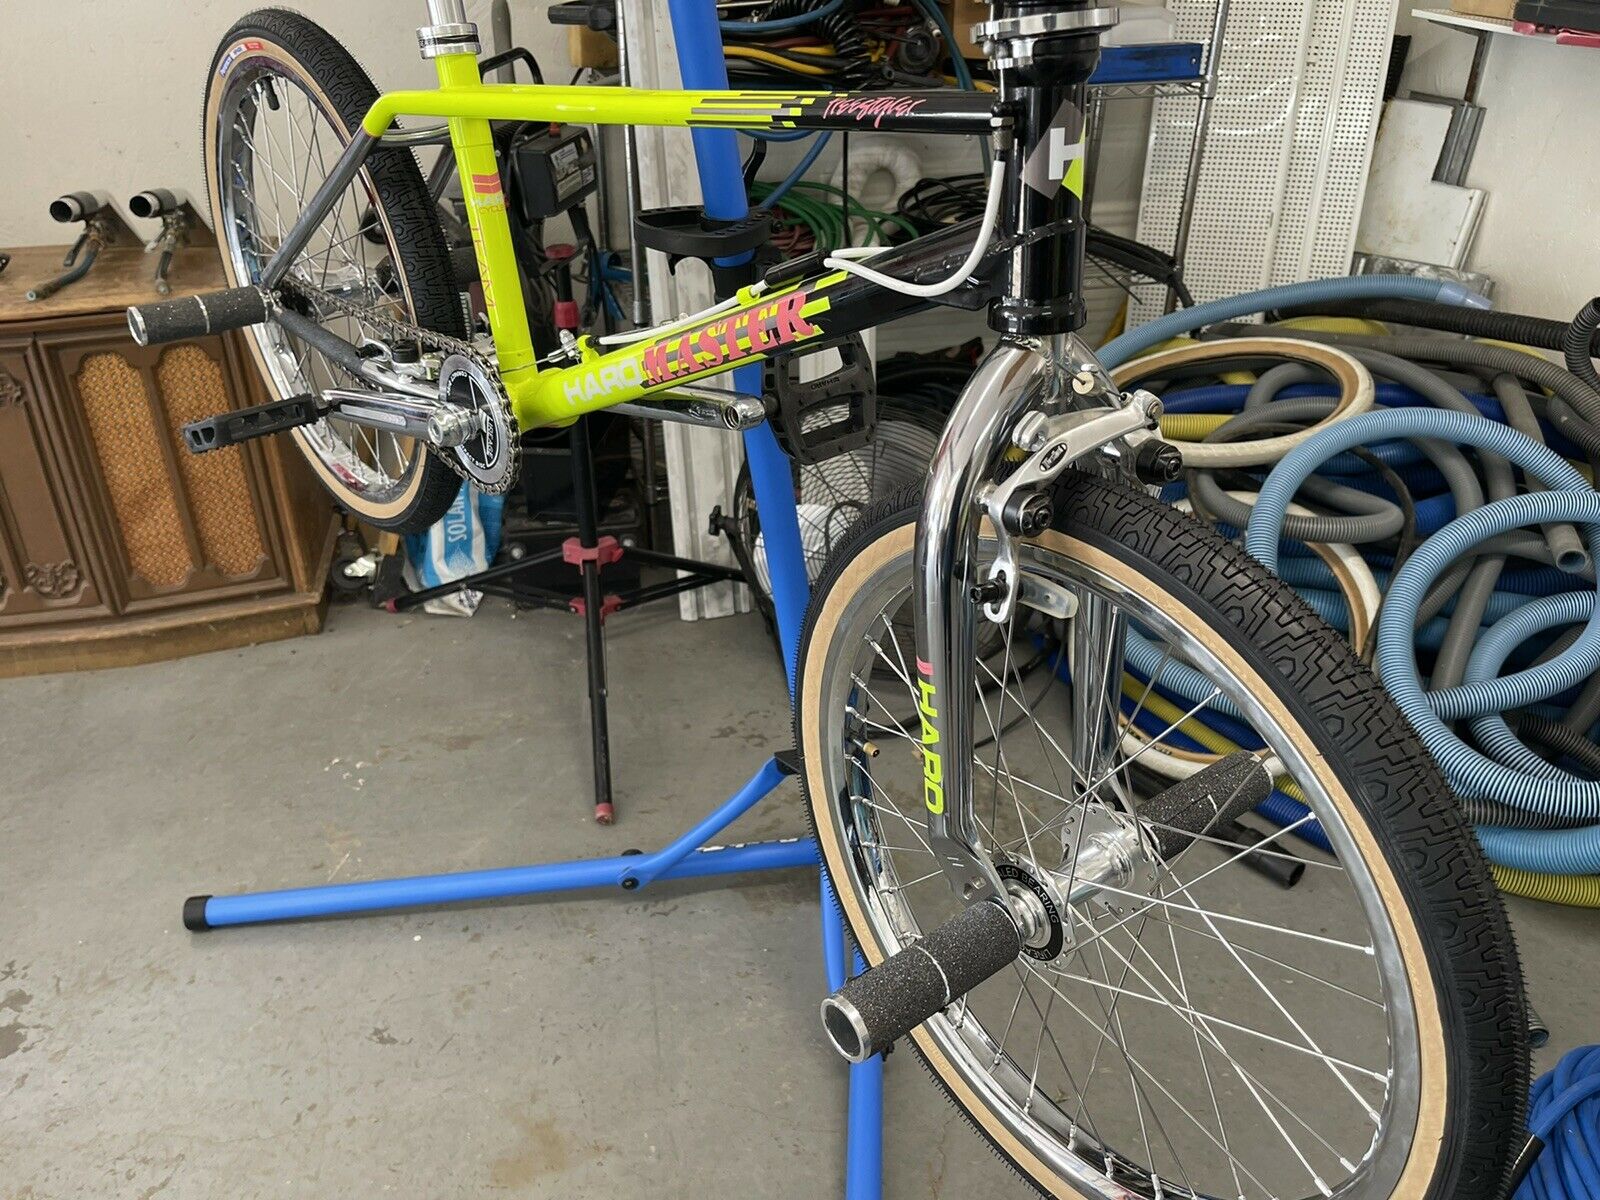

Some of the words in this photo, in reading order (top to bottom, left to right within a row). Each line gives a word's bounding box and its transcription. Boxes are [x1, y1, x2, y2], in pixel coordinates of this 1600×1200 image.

[562, 355, 644, 405] HARO
[642, 290, 816, 386] MASTER
[917, 676, 945, 816] HARO
[1021, 872, 1060, 925] BEARING
